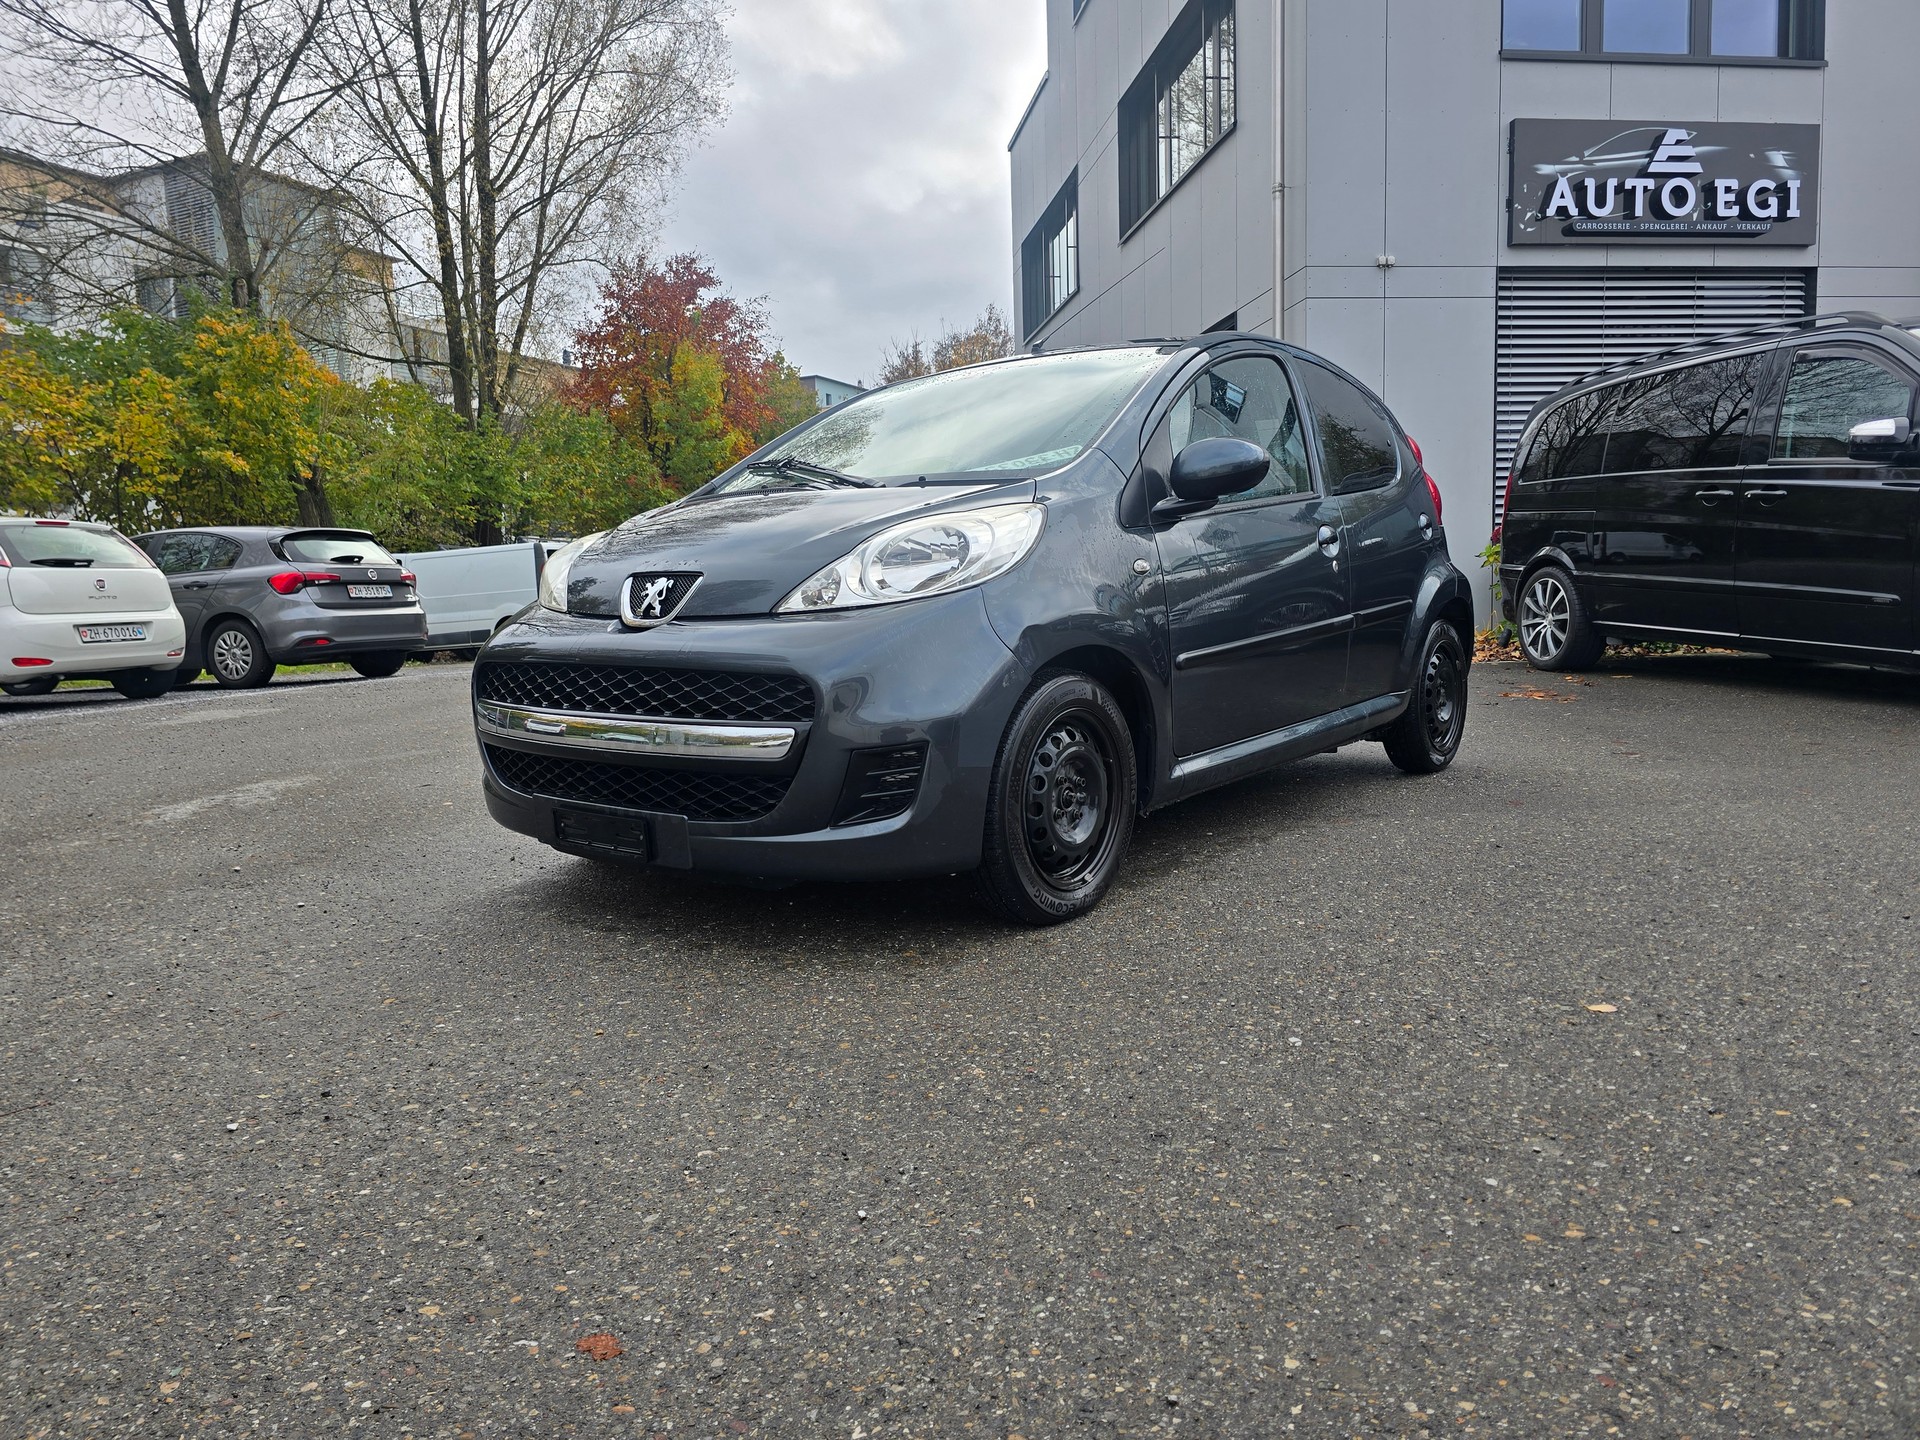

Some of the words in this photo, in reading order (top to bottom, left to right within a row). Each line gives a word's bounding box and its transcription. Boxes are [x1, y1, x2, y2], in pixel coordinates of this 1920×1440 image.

[1546, 177, 1696, 217] AUTO
[1714, 178, 1801, 218] EGI
[1575, 222, 1631, 230] CARROSSERIE
